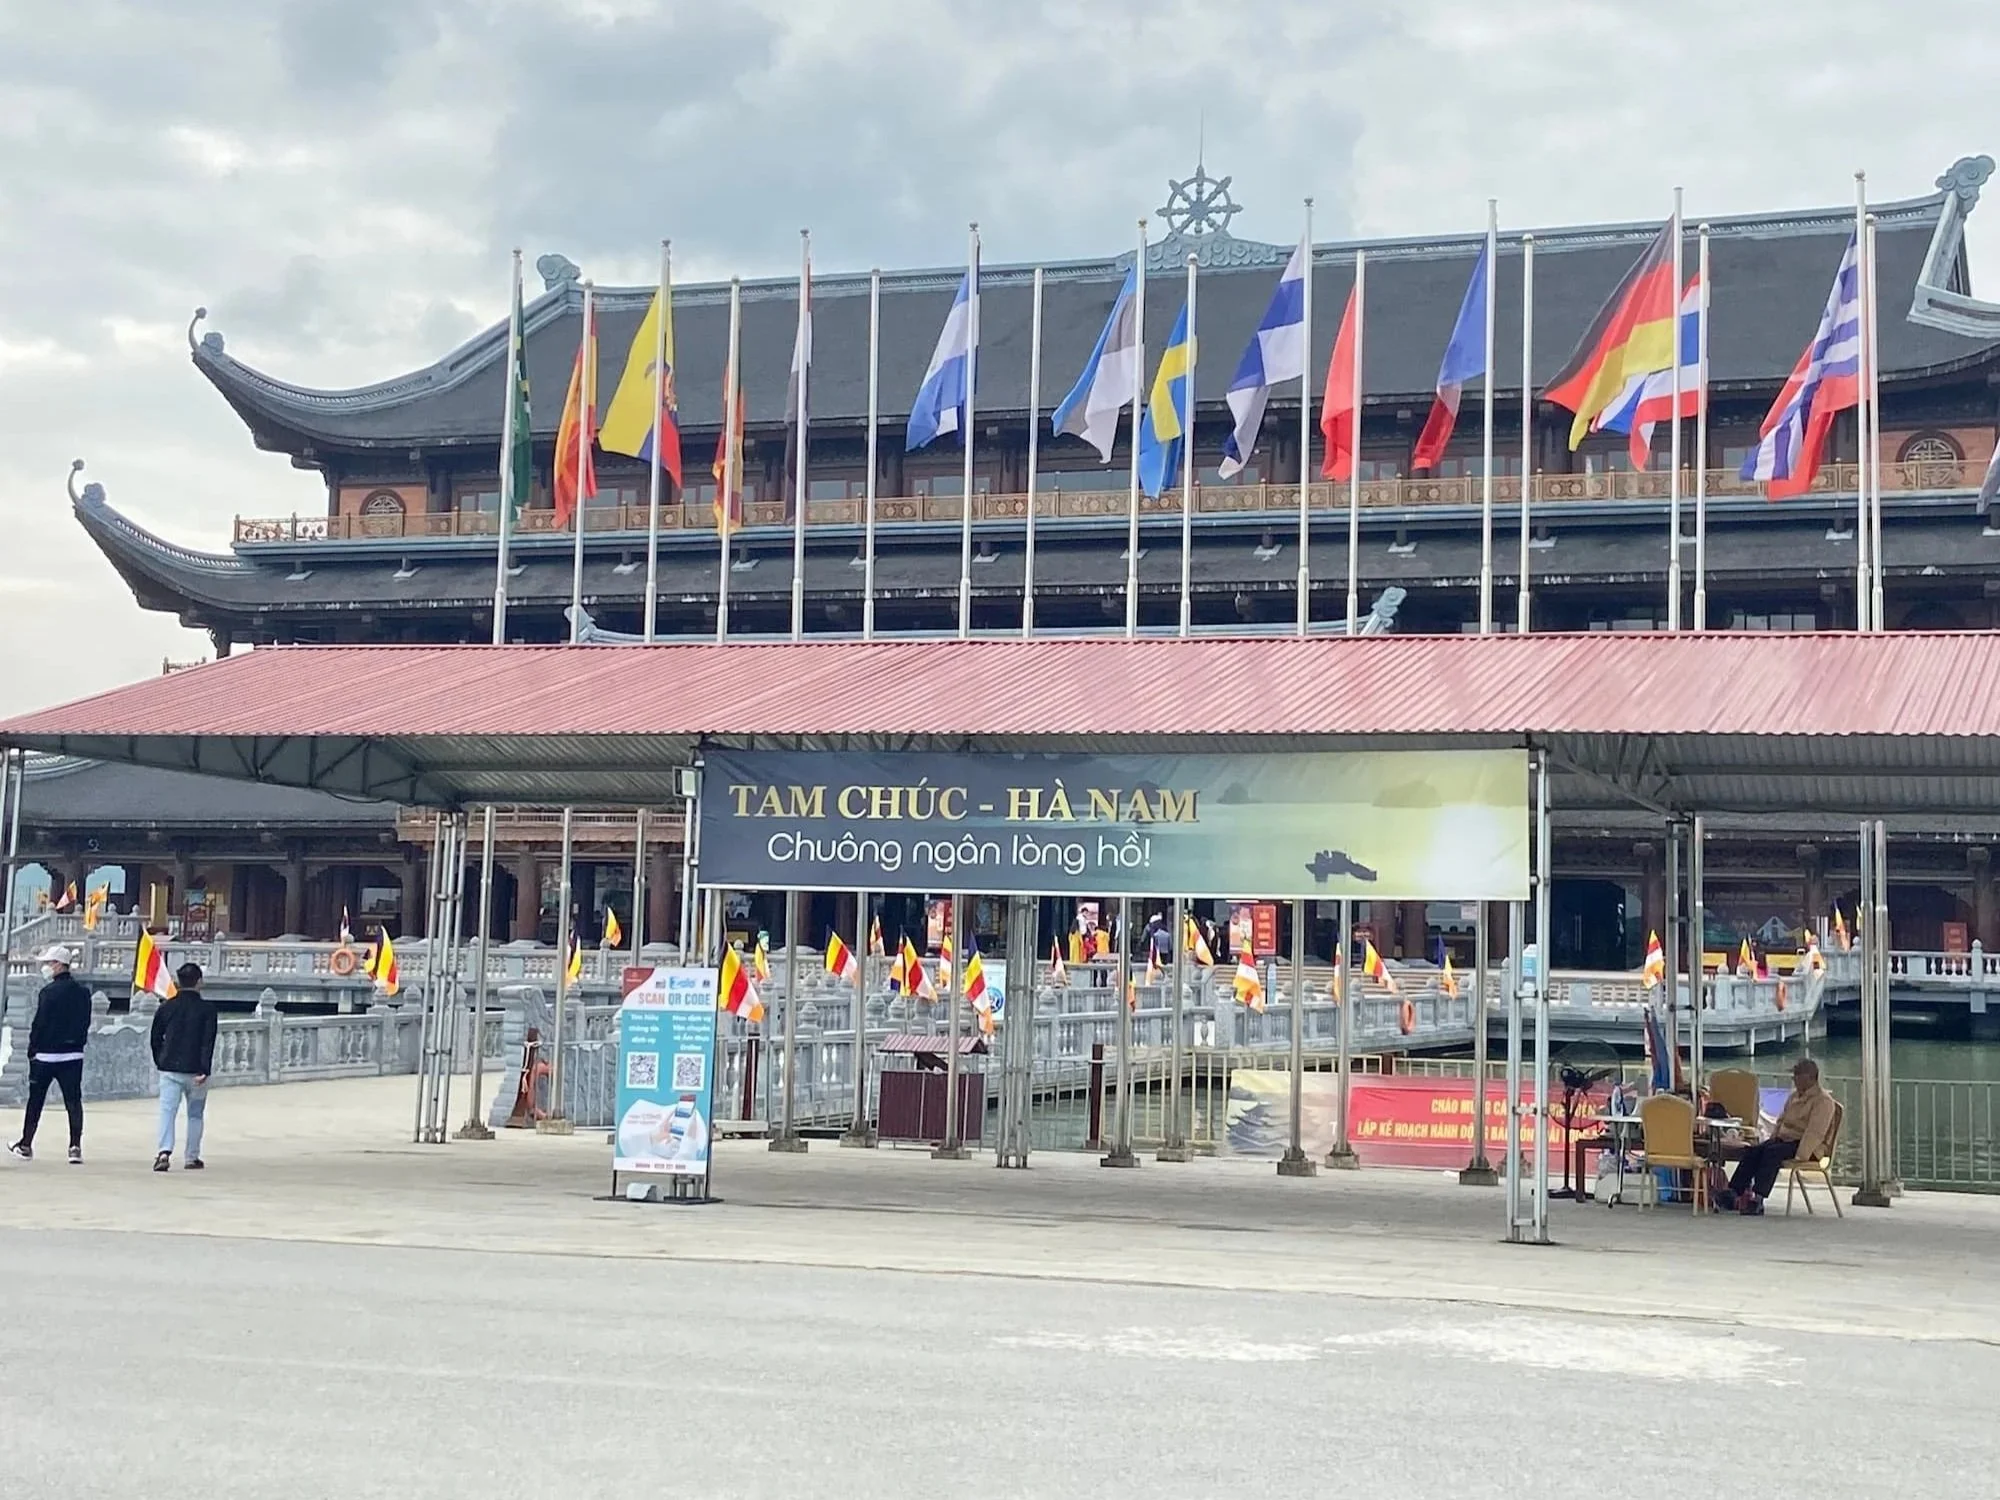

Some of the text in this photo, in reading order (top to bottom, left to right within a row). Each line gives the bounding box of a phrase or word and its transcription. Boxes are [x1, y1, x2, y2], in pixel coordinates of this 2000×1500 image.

[728, 785, 827, 818] TAM
[838, 776, 968, 820] CHÚC
[1004, 778, 1079, 822] HÀ
[1087, 788, 1200, 823] NAM
[768, 831, 1151, 875] Chuông ngân lòng hồ!
[639, 992, 711, 1005] SCAN QR CODE
